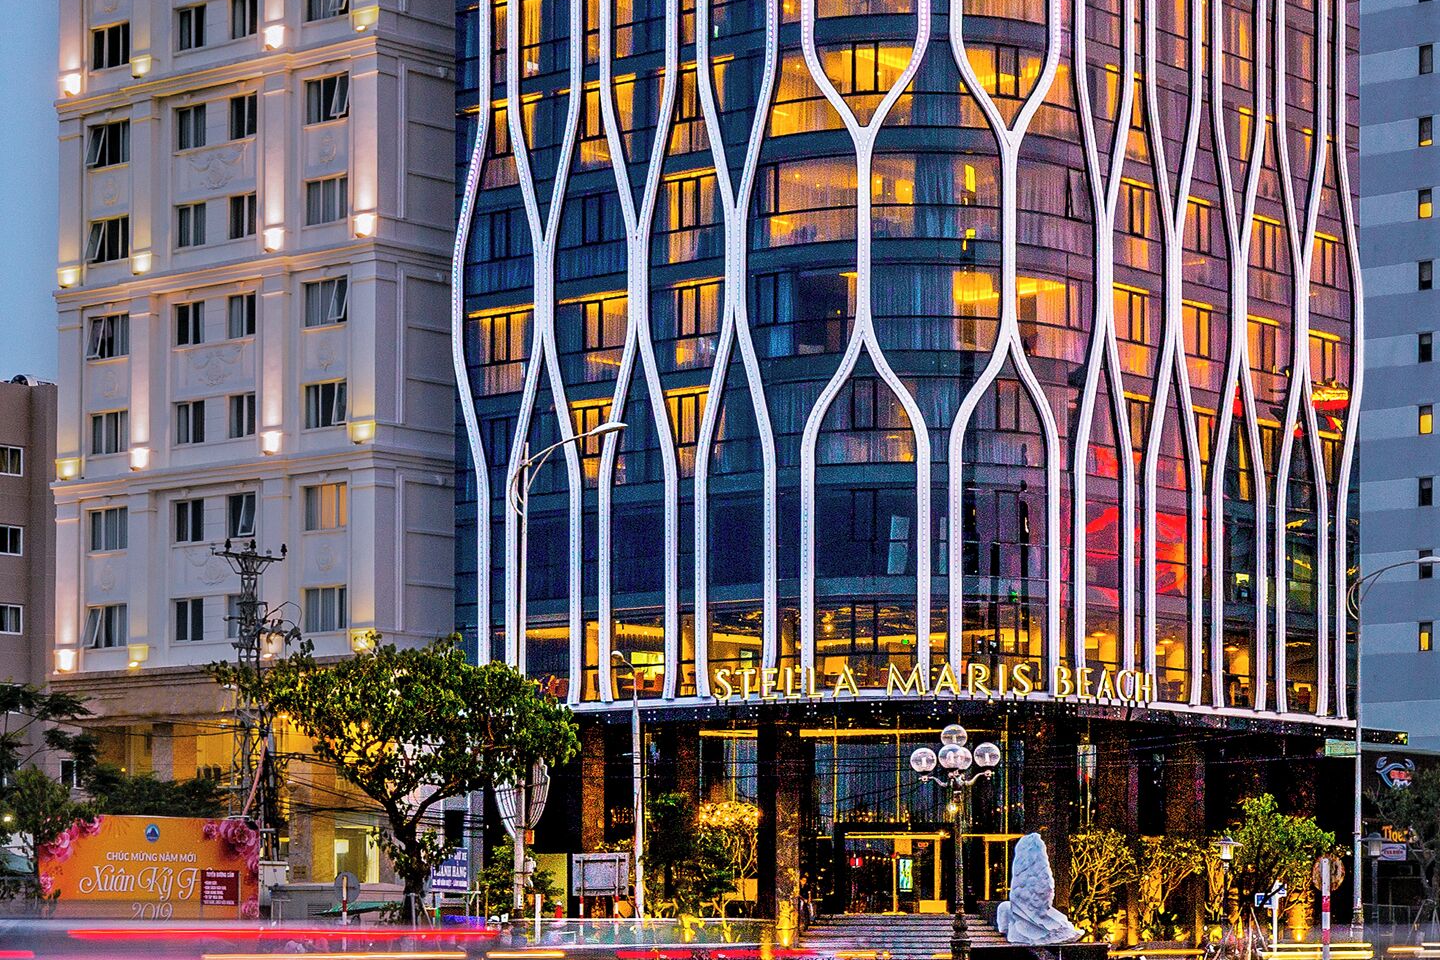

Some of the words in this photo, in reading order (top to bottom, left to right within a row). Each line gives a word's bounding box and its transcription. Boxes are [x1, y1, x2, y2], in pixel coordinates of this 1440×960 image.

[712, 666, 860, 702] STELLA
[886, 662, 1035, 697] MARIS
[1053, 665, 1154, 704] BEACH
[106, 850, 129, 861] CHÚC
[131, 851, 158, 862] MỪNG
[159, 851, 178, 862] NĂM
[179, 851, 197, 863] MỚI
[79, 864, 134, 894] Xuân
[137, 866, 174, 901] Kỷ
[131, 902, 173, 923] 2019
